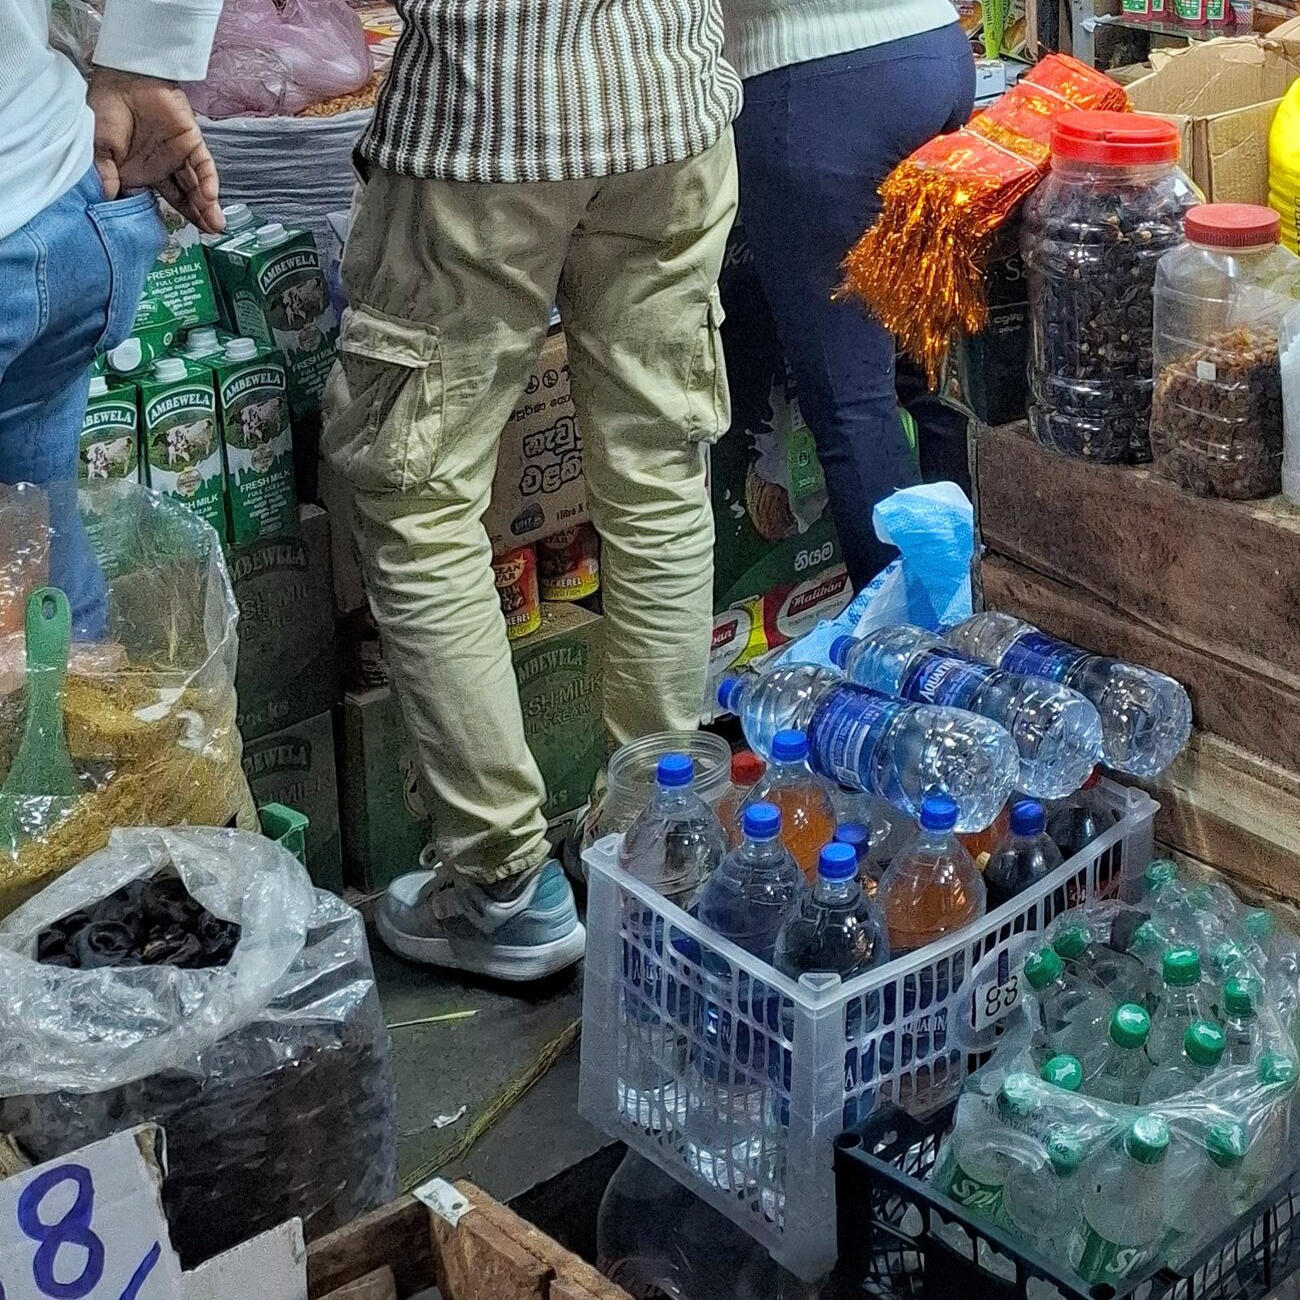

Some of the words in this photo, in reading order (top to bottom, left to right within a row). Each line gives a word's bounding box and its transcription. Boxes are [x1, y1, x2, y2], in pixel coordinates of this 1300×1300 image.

[147, 264, 179, 282] FRESH
[179, 261, 203, 275] MILK
[262, 252, 318, 288] AMBEWELA
[225, 372, 281, 401] AMBEWELA
[82, 410, 132, 429] BEWELA
[150, 394, 211, 421] AMBEWELA
[240, 479, 268, 493] FRESH
[268, 469, 292, 485] MILK
[228, 546, 306, 585] MBEWELA
[792, 572, 847, 609] Maliban
[518, 647, 583, 685] MBEWELA
